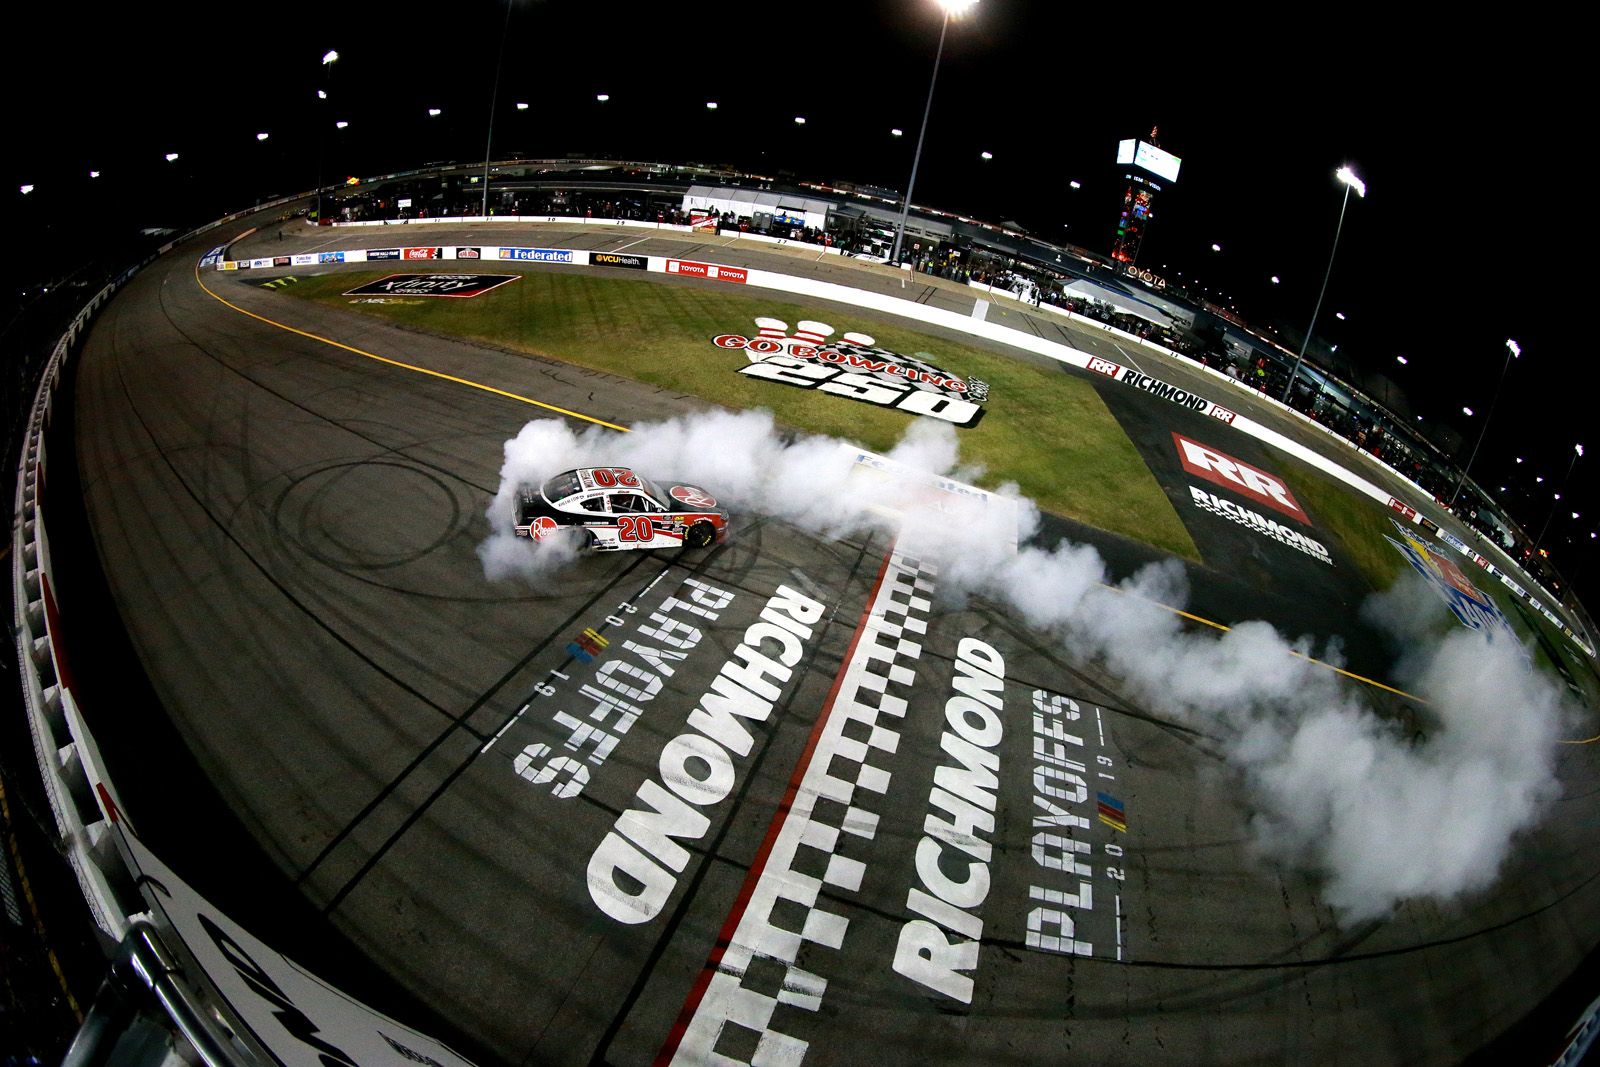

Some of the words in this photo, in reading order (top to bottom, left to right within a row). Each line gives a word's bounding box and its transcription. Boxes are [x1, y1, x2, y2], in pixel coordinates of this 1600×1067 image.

[514, 249, 573, 262] Federated
[680, 265, 705, 273] TOYOTA
[719, 270, 745, 279] TOYOTA
[1128, 266, 1166, 288] OYOTA
[711, 334, 782, 354] GO
[788, 343, 969, 393] BOWLING
[735, 356, 983, 425] 250
[1089, 359, 1119, 376] RR
[1121, 369, 1207, 412] RICHMOND
[1212, 408, 1235, 424] RR
[591, 468, 641, 488] 20
[1179, 438, 1300, 512] RR
[617, 515, 655, 543] 20
[1189, 485, 1329, 556] RICHMOND
[605, 602, 638, 627] 20
[513, 577, 736, 799] PLAYOFFS
[533, 669, 571, 697] 19
[586, 584, 826, 925] RICHMOND
[1096, 755, 1115, 780] 19
[892, 637, 1006, 1005] RICHMOND
[1025, 689, 1093, 957] PLAYOFFS
[1104, 843, 1126, 882] 20
